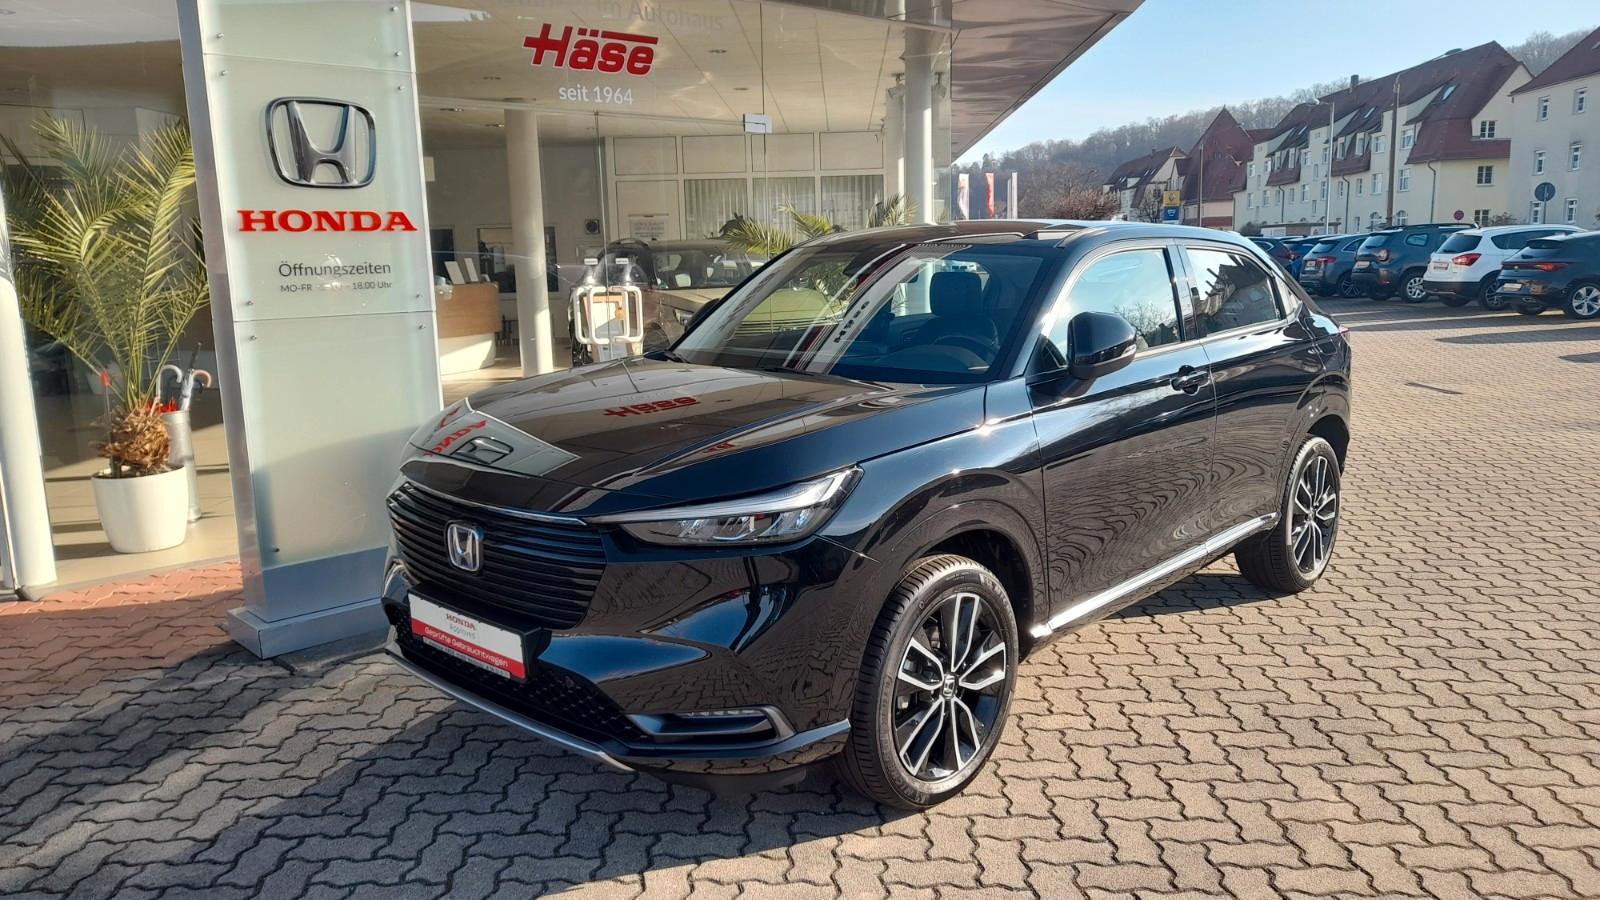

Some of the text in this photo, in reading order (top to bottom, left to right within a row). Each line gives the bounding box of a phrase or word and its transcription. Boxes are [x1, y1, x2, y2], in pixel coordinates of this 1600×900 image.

[522, 22, 659, 76] Häse
[558, 84, 634, 105] seit 1964
[236, 209, 418, 233] HONDA
[278, 260, 392, 279] Öffnungszeiten
[280, 283, 313, 293] MO-FR
[377, 281, 392, 289] Uhr
[445, 613, 477, 631] HONDA
